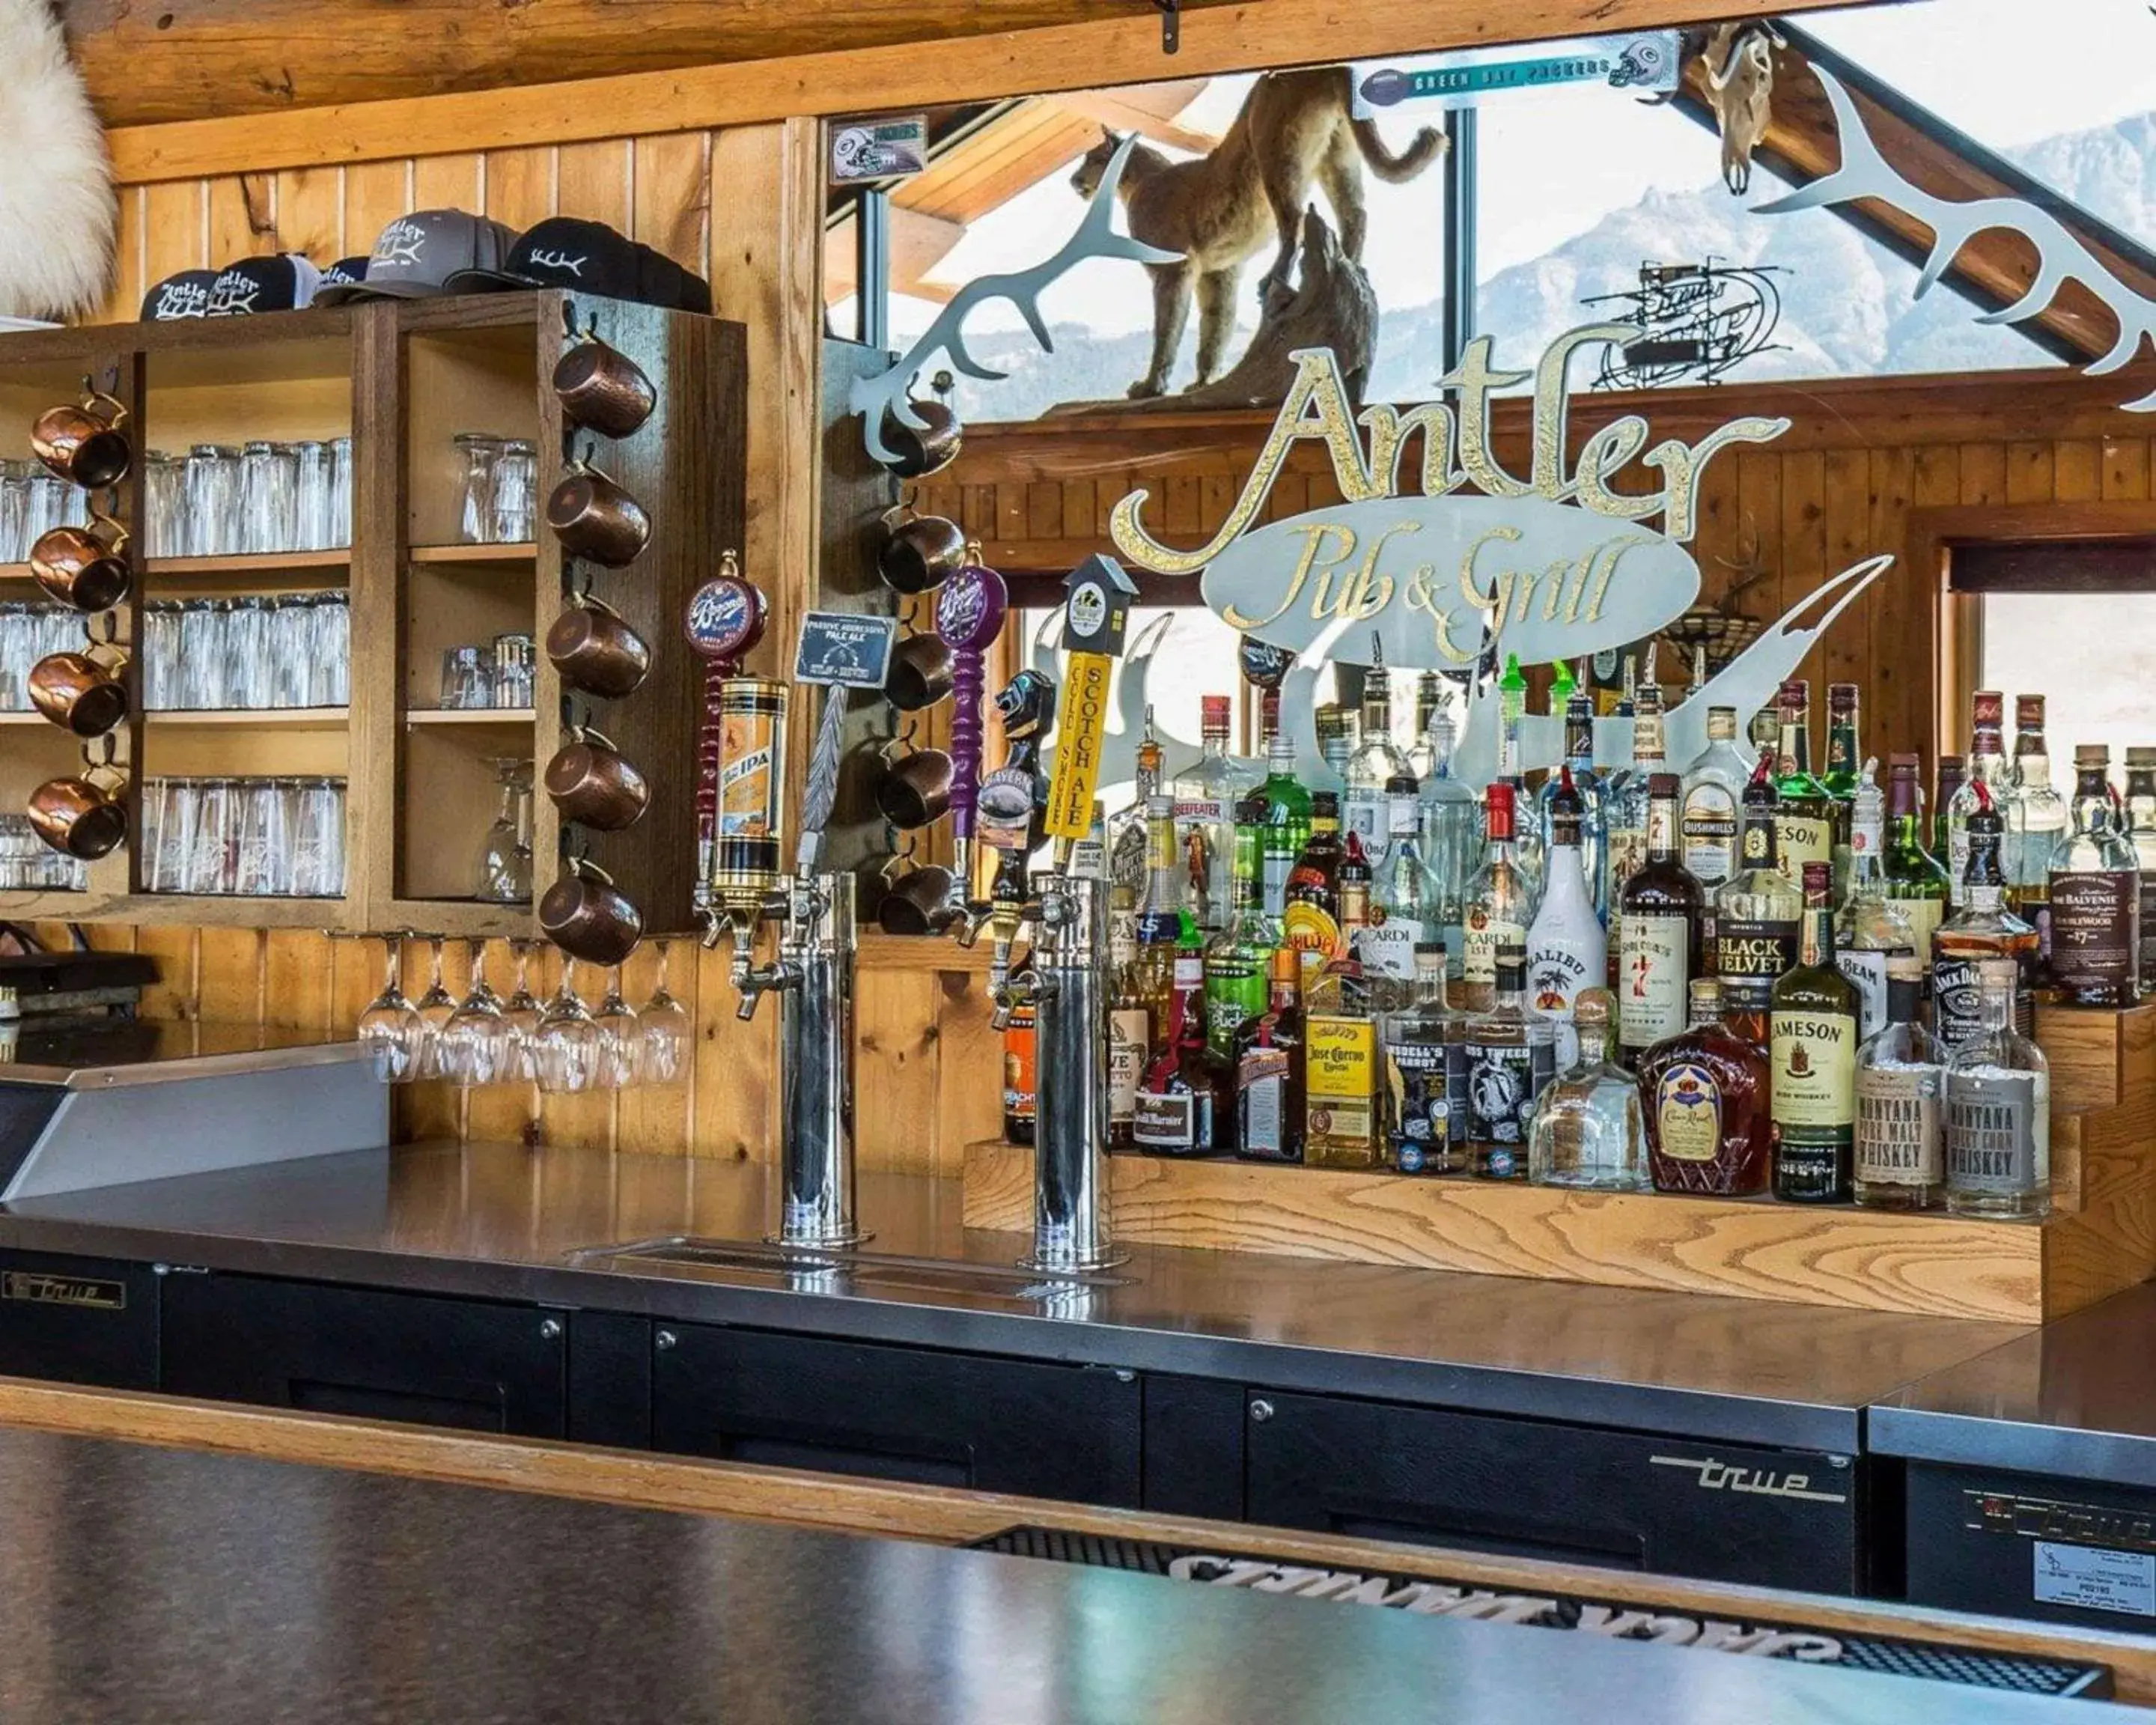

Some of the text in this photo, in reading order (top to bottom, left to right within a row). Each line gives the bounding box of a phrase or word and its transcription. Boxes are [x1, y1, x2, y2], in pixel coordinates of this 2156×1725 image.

[1414, 73, 1470, 91] GREEN
[1527, 58, 1610, 82] PACKERS
[161, 282, 207, 301] Antle
[1111, 322, 1792, 575] Antler
[1222, 520, 1666, 665] Pub & Grill
[1067, 666, 1102, 827] SCOTCH ALE
[740, 751, 769, 776] IPA
[1174, 802, 1221, 817] BEEFEATER
[1684, 821, 1735, 834] BUSHMILLS
[1776, 825, 1818, 847] ESON
[2065, 893, 2119, 904] BALVENIE
[1717, 937, 1781, 956] BLACK
[2074, 931, 2088, 945] 17
[1308, 1043, 1365, 1063] Jose Cuervo
[1859, 1095, 1922, 1122] MONTANA
[1950, 1103, 2013, 1131] MONTANA
[1889, 1122, 1922, 1143] MALT
[1860, 1140, 1922, 1168] WHISKEY
[1950, 1147, 2013, 1175] WHISKEY
